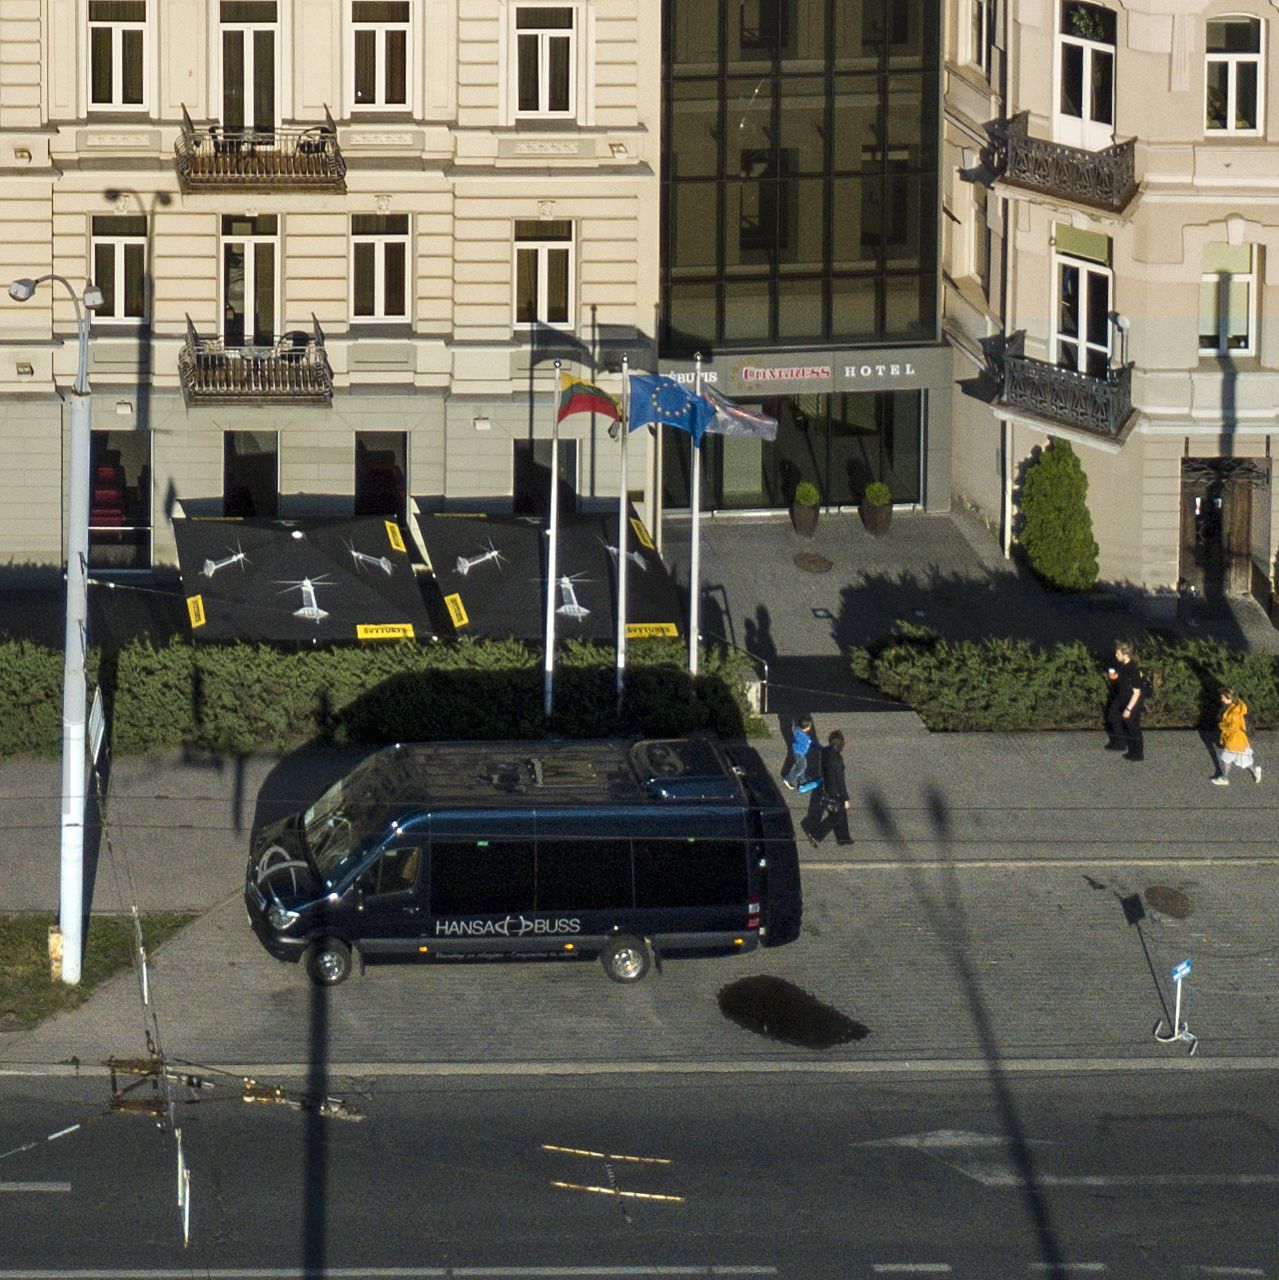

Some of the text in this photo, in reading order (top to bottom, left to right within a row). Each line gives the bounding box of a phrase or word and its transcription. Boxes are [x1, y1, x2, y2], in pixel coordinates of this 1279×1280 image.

[742, 365, 831, 381] CONGRESS
[845, 363, 915, 378] HOTEL
[436, 919, 580, 935] HANSA BUSS
